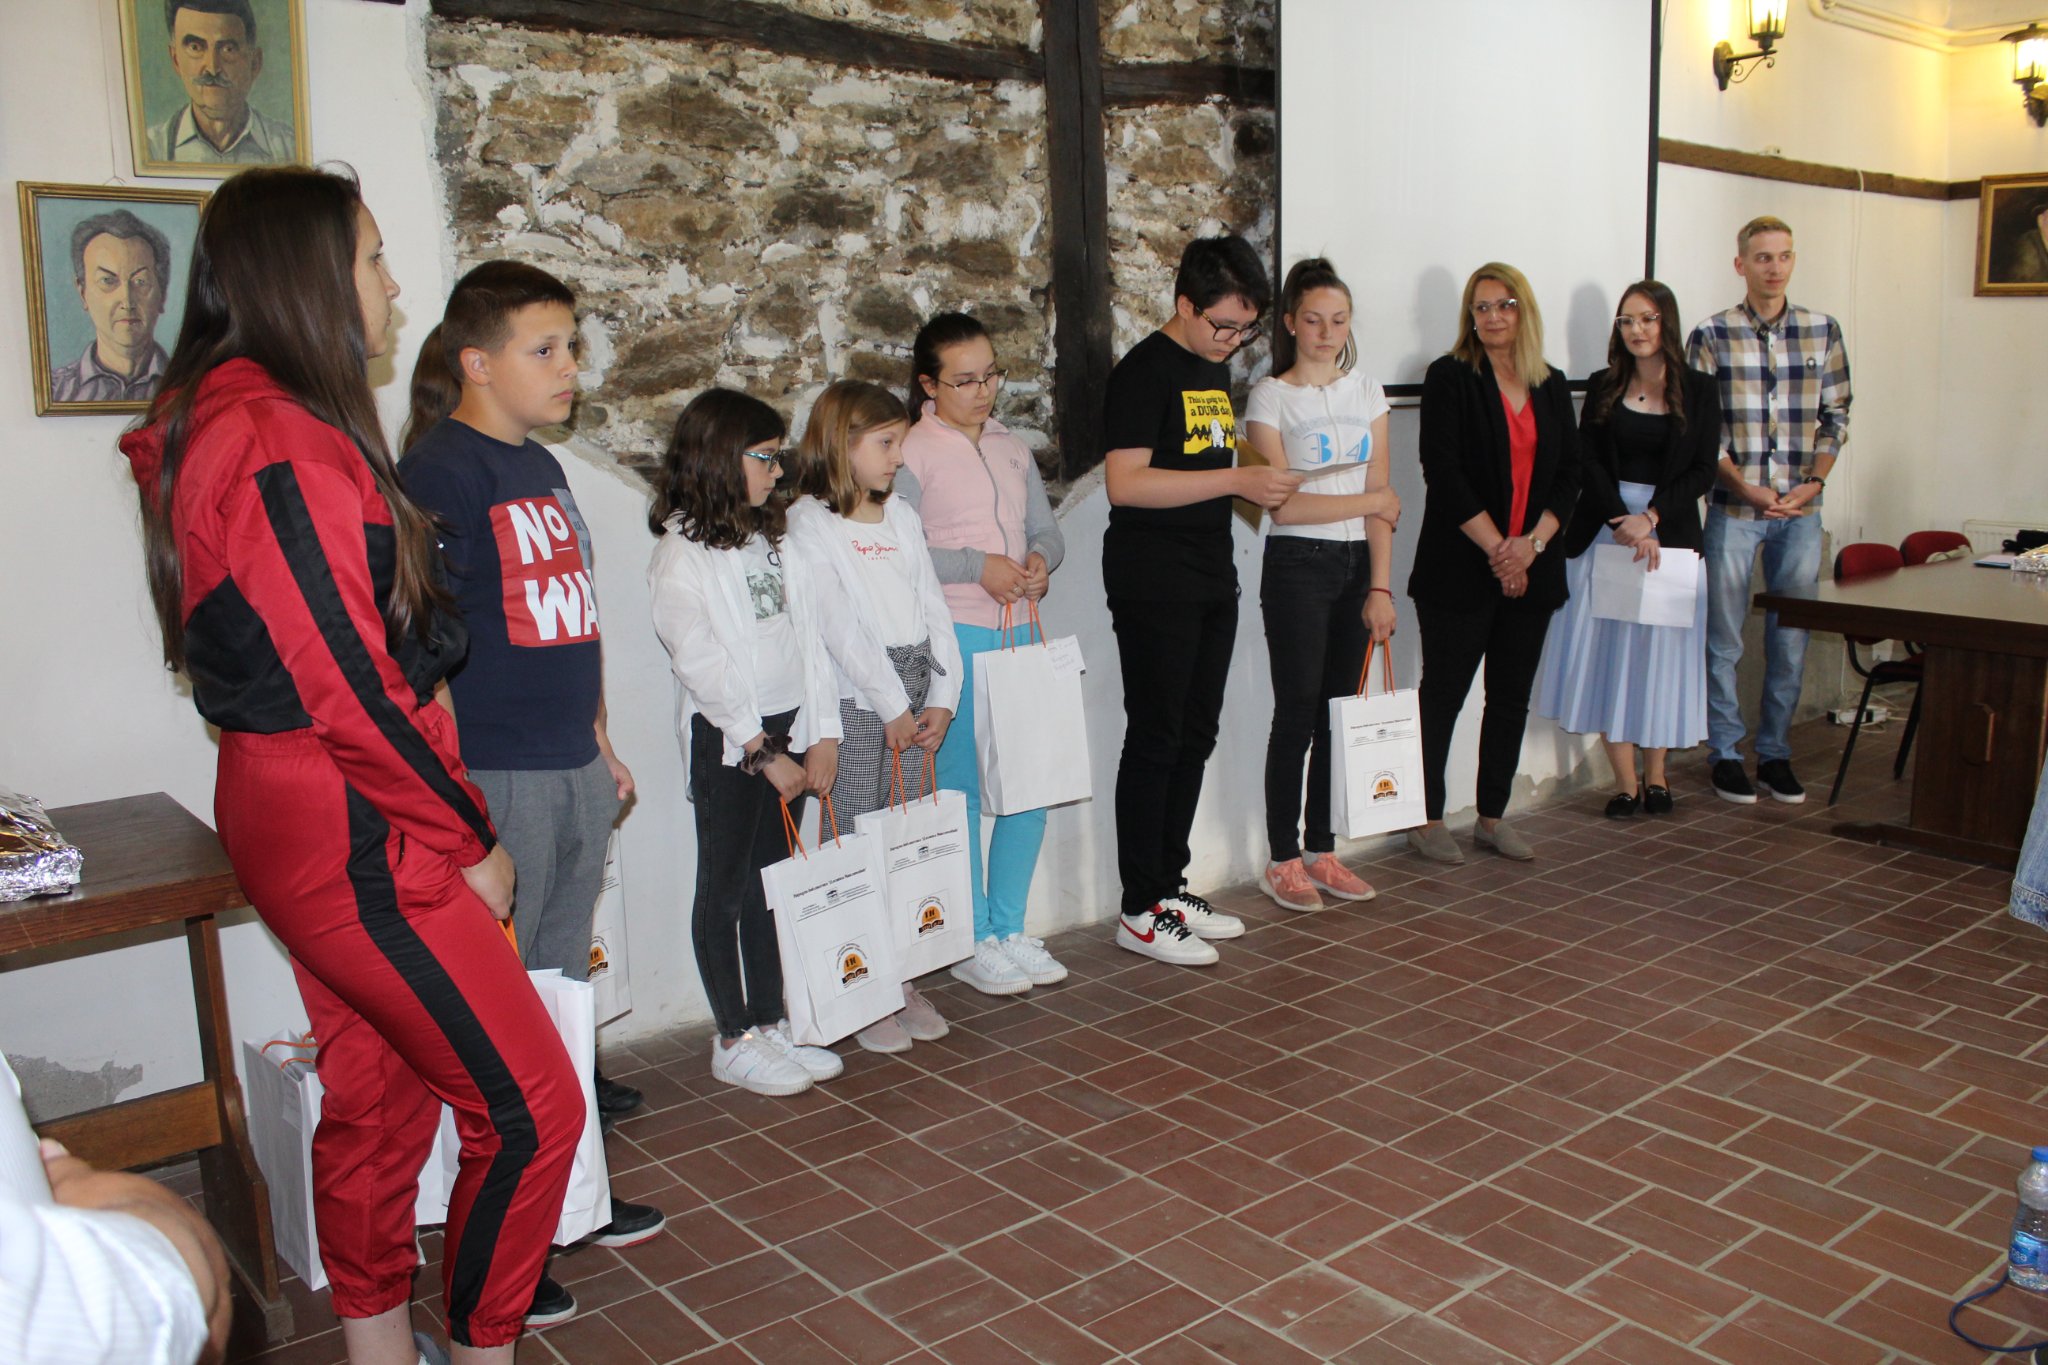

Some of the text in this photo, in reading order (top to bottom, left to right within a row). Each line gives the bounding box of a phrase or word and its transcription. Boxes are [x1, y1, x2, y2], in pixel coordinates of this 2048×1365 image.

[1190, 408, 1197, 416] a
[1197, 405, 1220, 416] DUMB
[524, 568, 600, 640] WA
